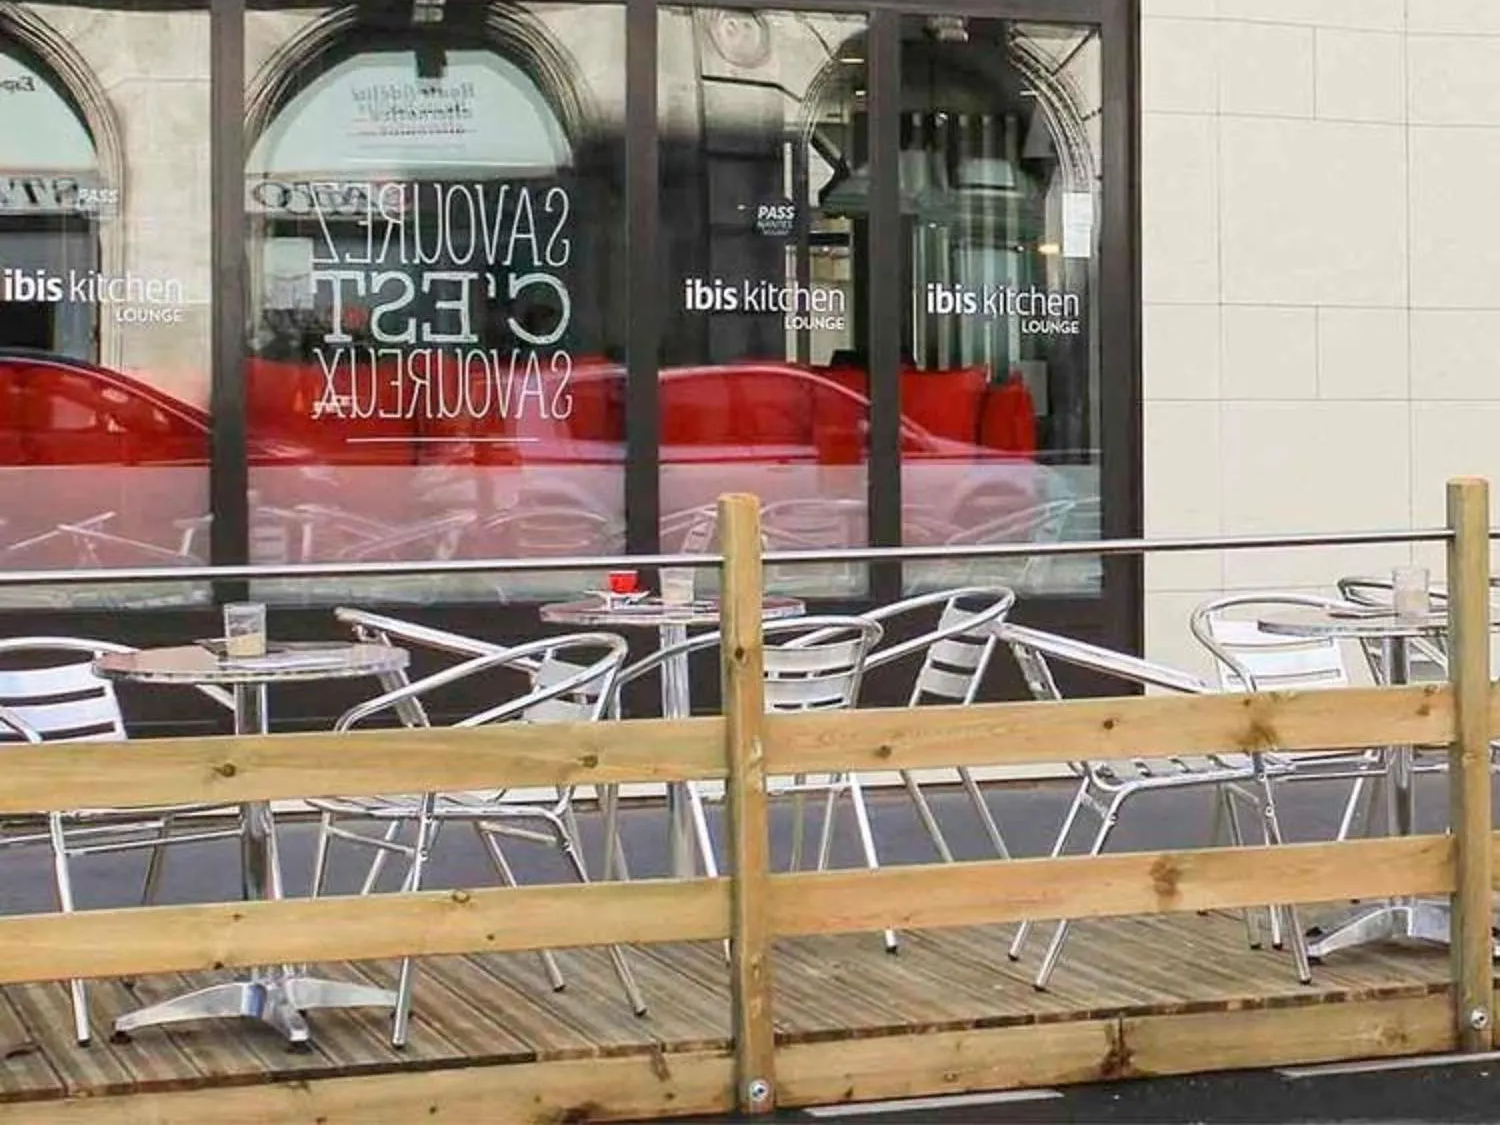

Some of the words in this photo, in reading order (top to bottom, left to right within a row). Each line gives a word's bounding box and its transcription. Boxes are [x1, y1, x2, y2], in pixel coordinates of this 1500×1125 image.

[757, 204, 796, 220] PASS
[4, 268, 64, 303] ibis
[70, 269, 184, 305] kitchen
[685, 278, 739, 310] ibis
[743, 279, 846, 312] kitchen
[926, 282, 977, 314] ibis
[983, 283, 1080, 317] kitchen
[115, 307, 186, 323] LOUNGE
[784, 316, 845, 331] LOUNGE
[1021, 320, 1081, 335] LOUNGE
